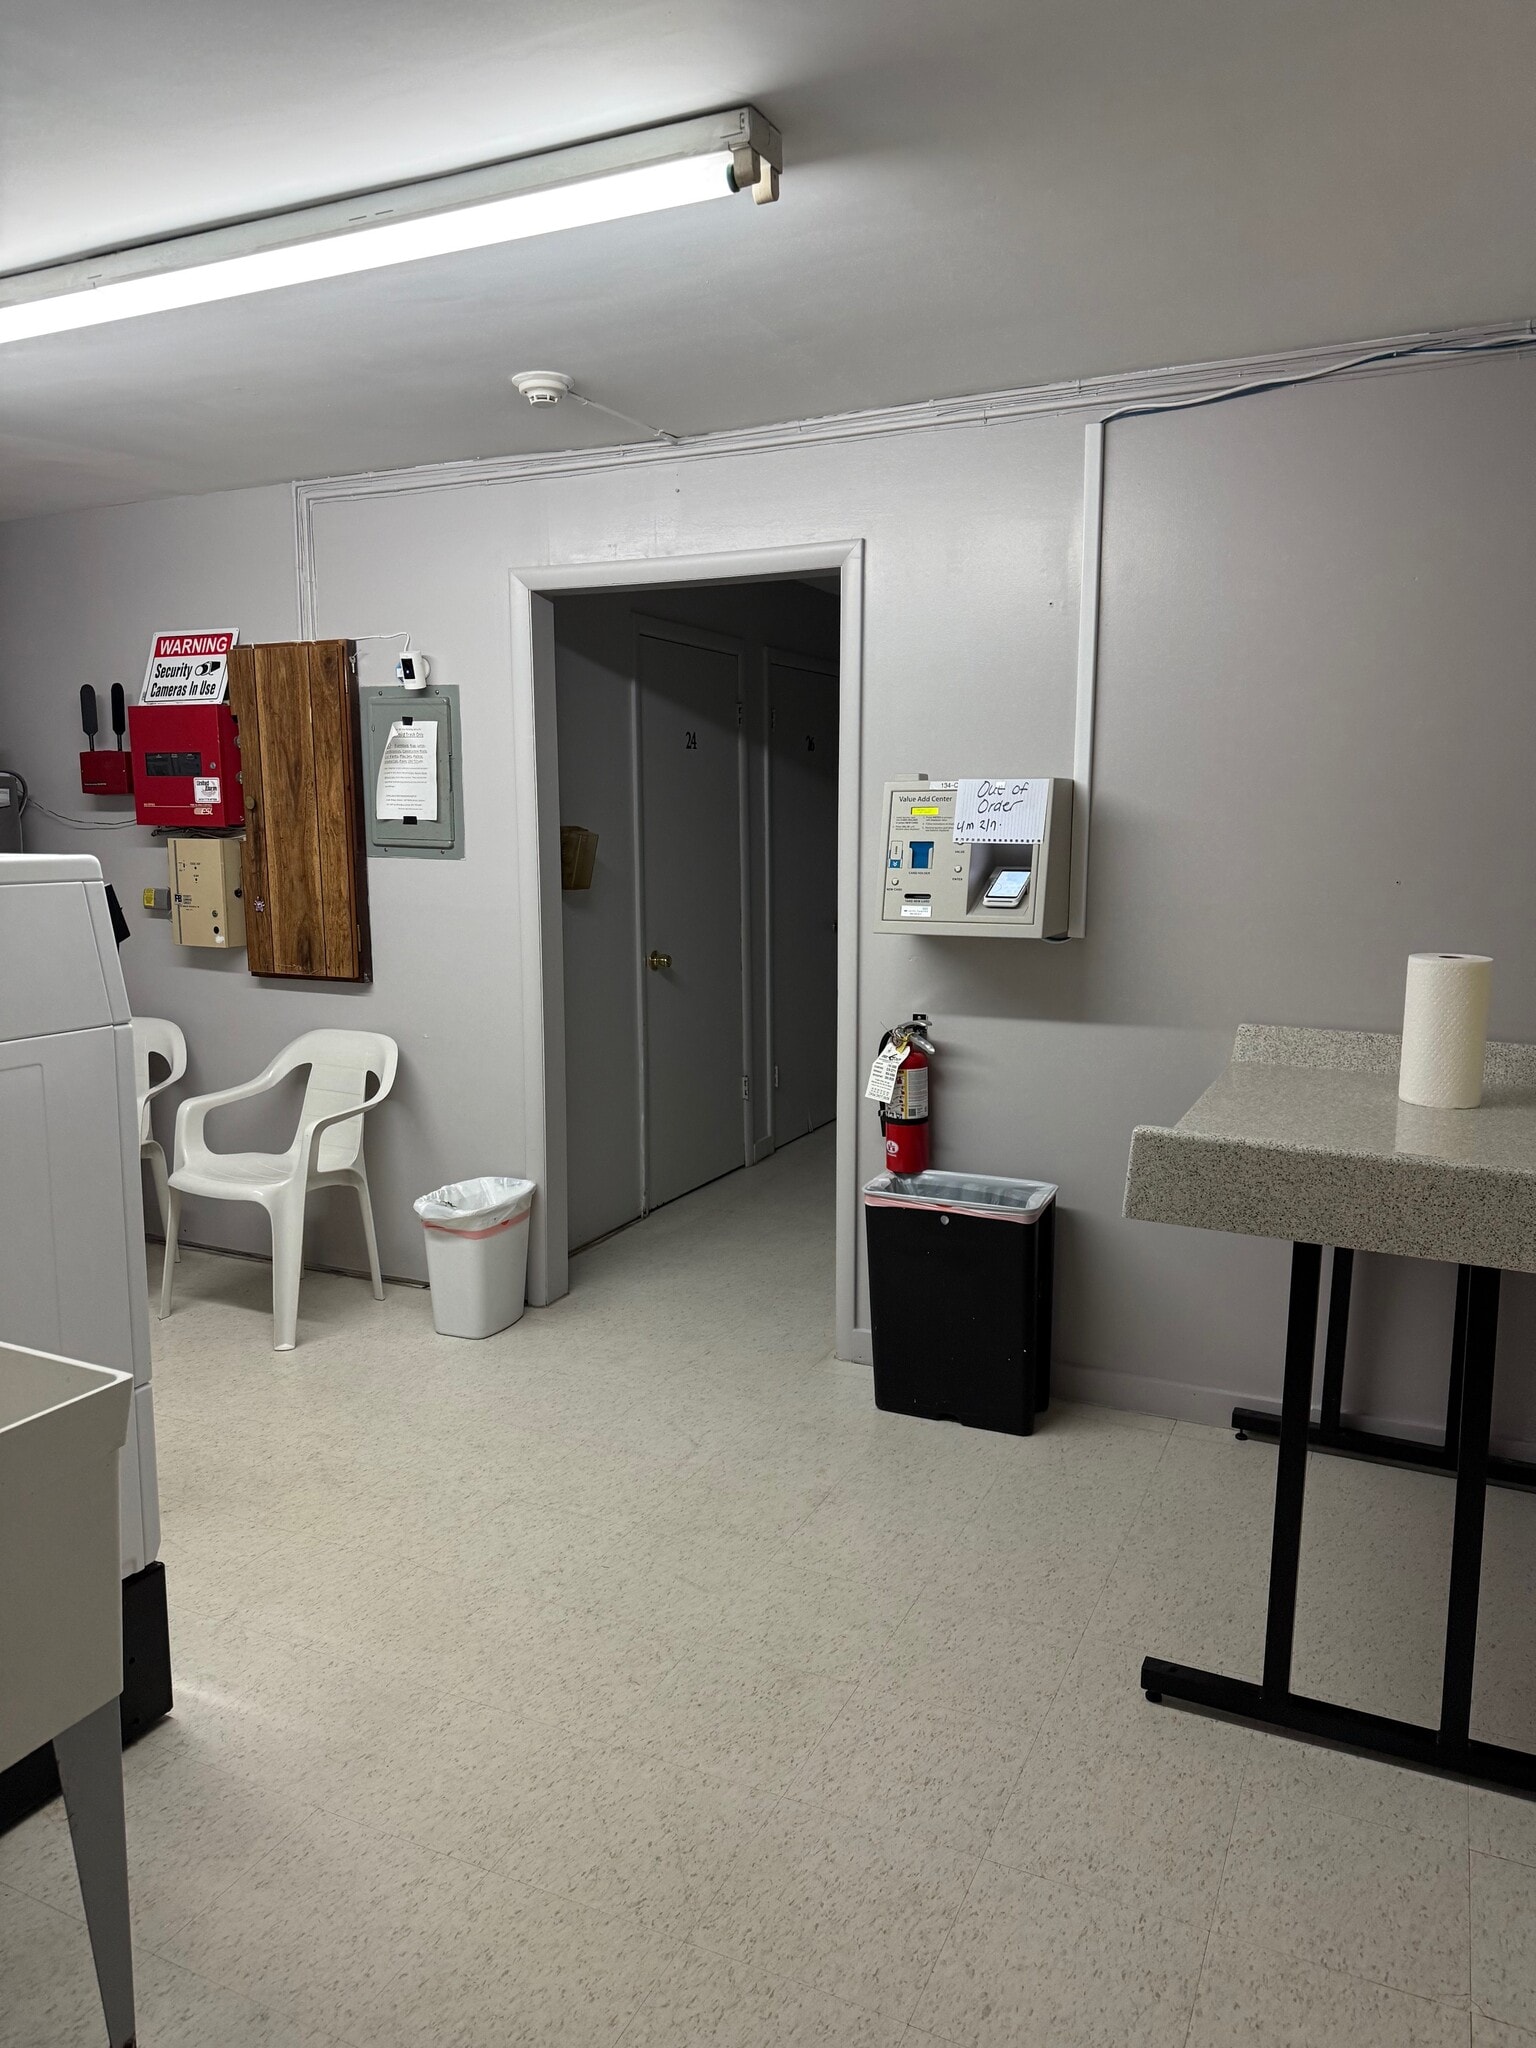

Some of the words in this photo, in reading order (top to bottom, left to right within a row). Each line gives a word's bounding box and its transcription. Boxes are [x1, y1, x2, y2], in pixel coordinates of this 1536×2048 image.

[160, 637, 228, 655] WARNING
[154, 662, 193, 680] Security
[150, 682, 187, 698] Cameras
[188, 681, 198, 696] In
[200, 680, 216, 696] Use
[686, 731, 698, 750] 24
[805, 735, 816, 752] 26
[977, 780, 1006, 798] Out
[1011, 781, 1029, 795] of
[977, 798, 1024, 814] Order
